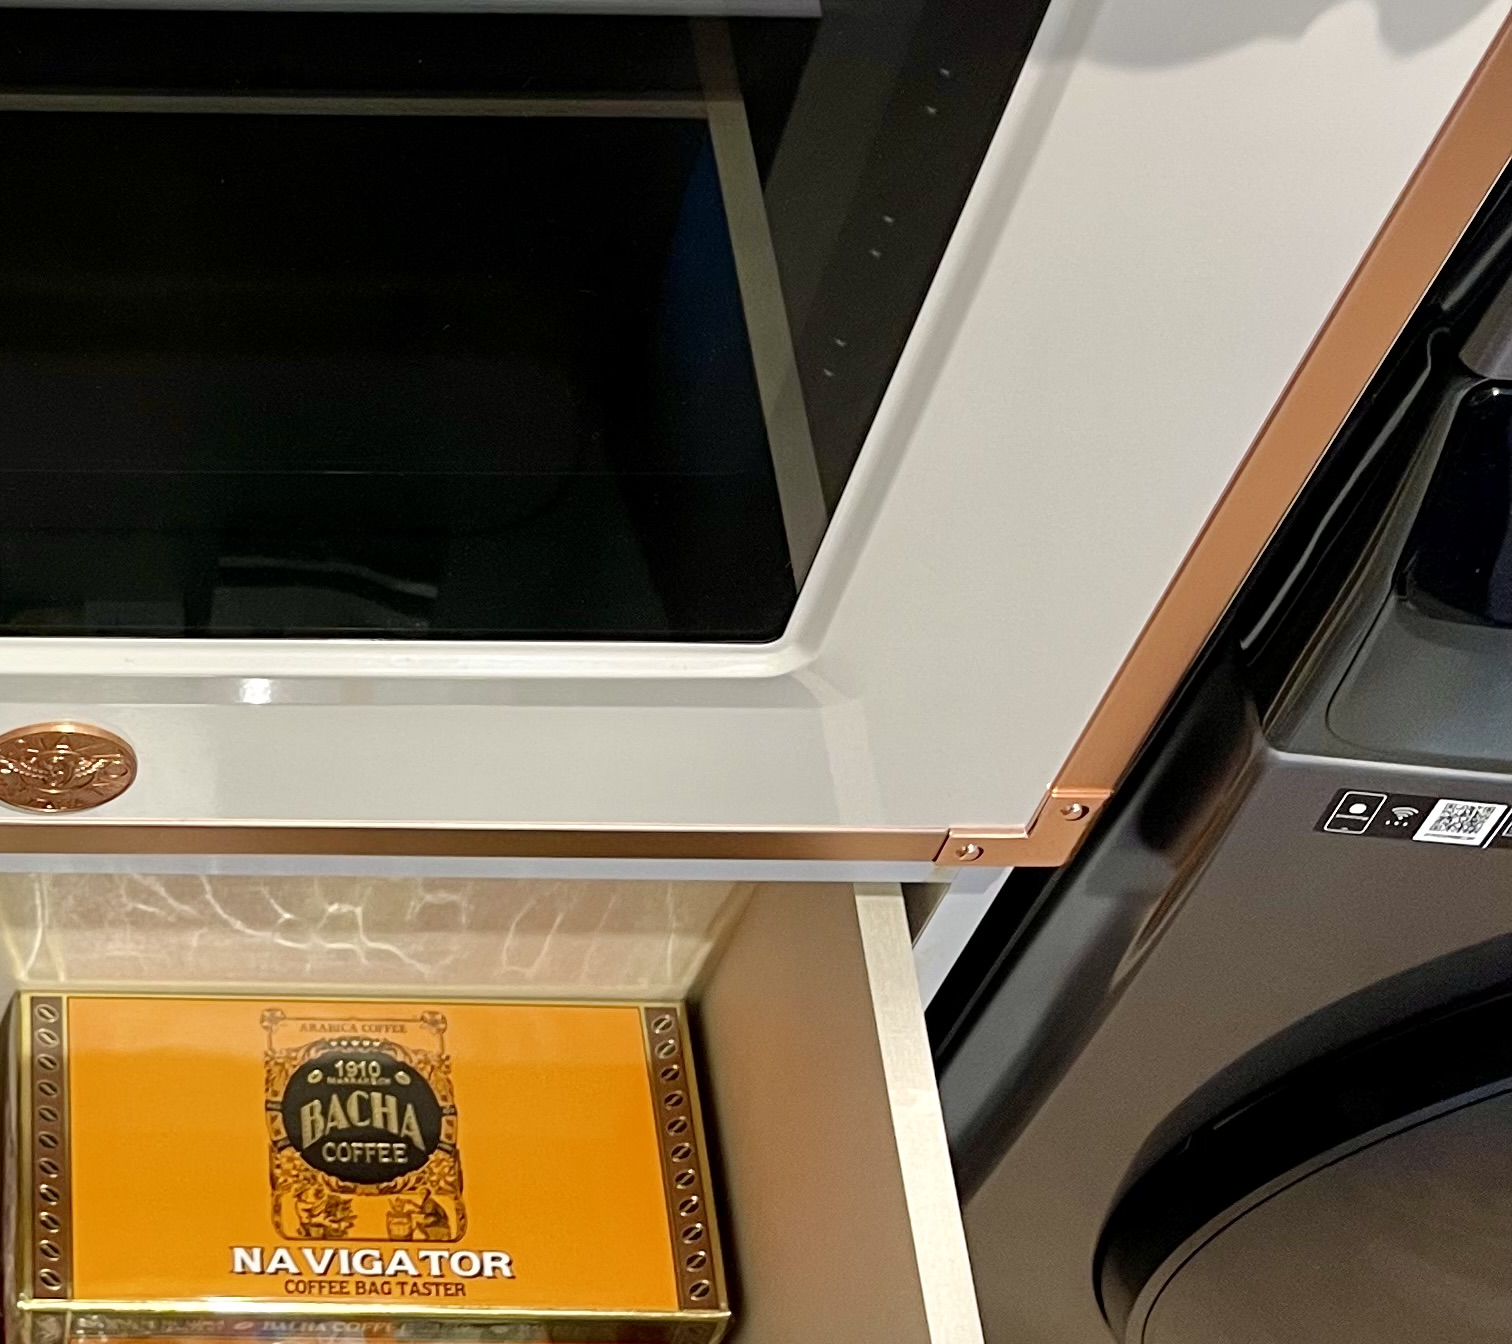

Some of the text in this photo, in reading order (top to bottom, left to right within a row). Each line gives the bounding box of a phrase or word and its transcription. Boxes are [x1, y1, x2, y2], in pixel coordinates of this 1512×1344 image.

[299, 1023, 408, 1034] ARABICA COFFEE
[334, 1060, 382, 1077] 1910
[300, 1090, 426, 1151] BACHA
[322, 1141, 408, 1164] COFFEE
[231, 1246, 515, 1278] NAVIGATOR
[284, 1279, 466, 1297] COFFEE BAG TASTER
